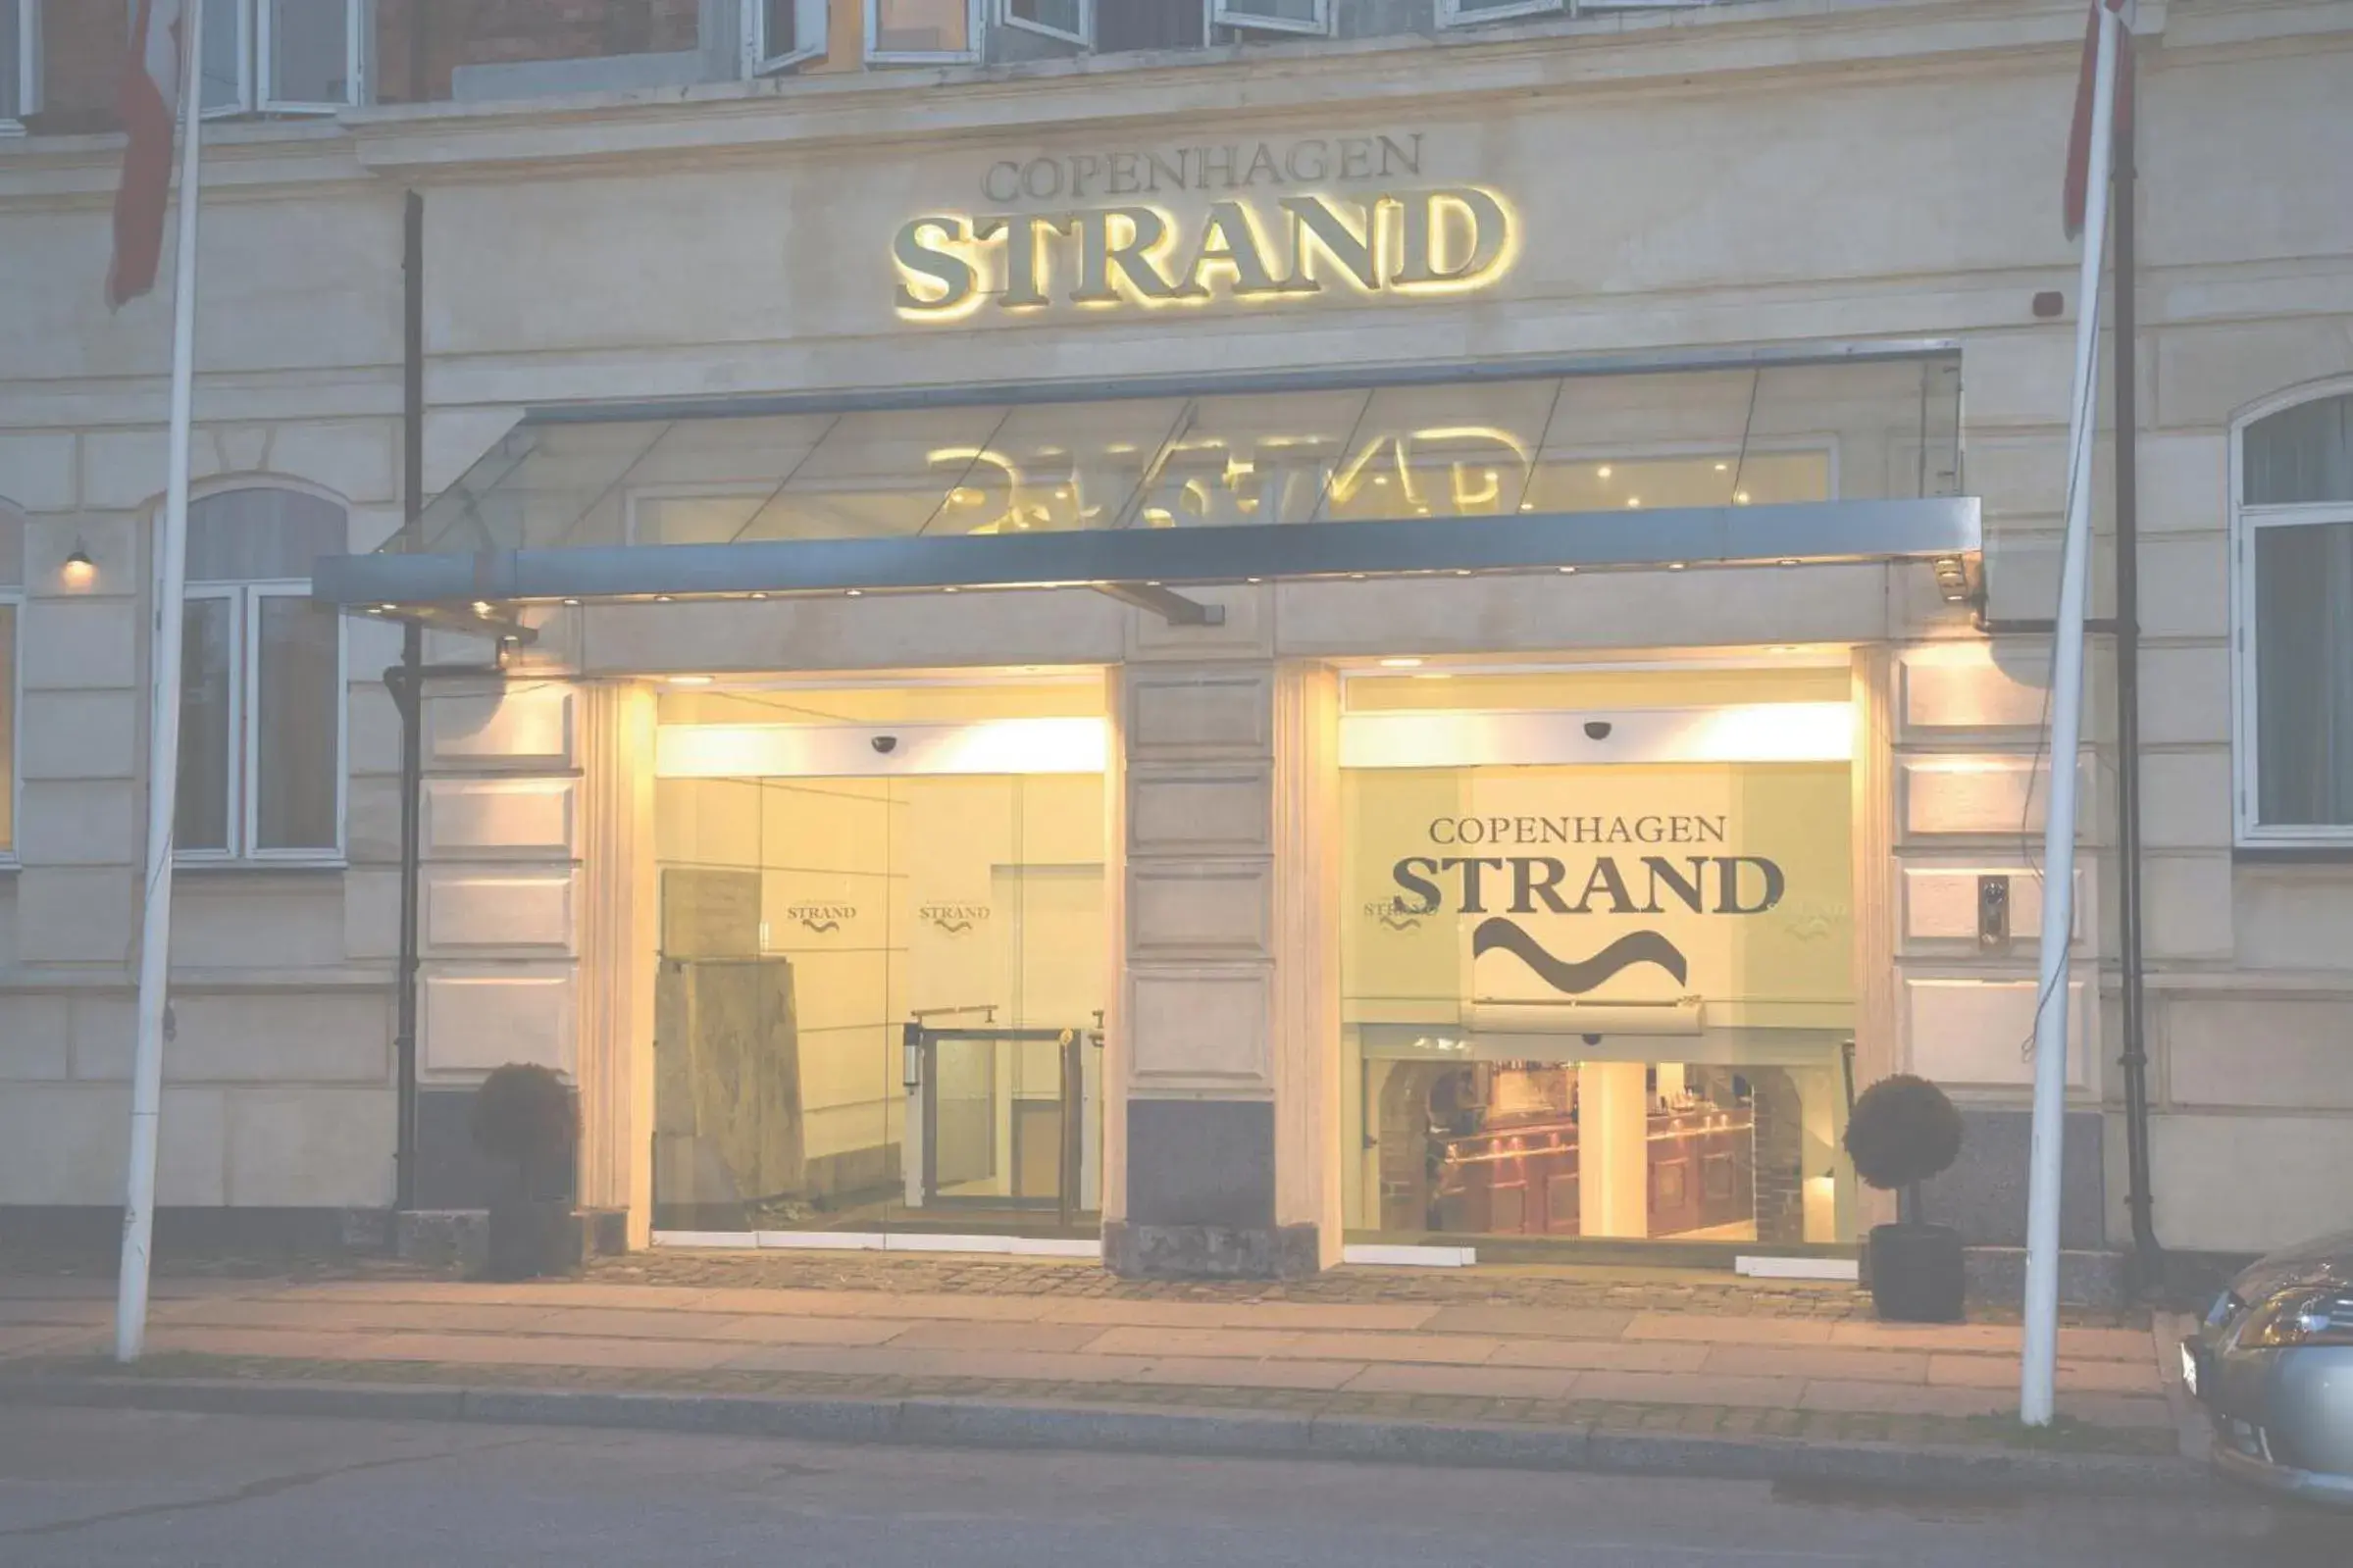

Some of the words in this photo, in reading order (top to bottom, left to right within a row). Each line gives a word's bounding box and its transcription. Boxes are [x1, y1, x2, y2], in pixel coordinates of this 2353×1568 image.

[984, 133, 1425, 203] COPENHAGEN
[894, 188, 1509, 311] STRAND
[1429, 815, 1727, 844] COPENHAGEN
[1393, 856, 1785, 914] STRAND
[787, 906, 857, 920] STRAND
[919, 906, 991, 920] STRAND
